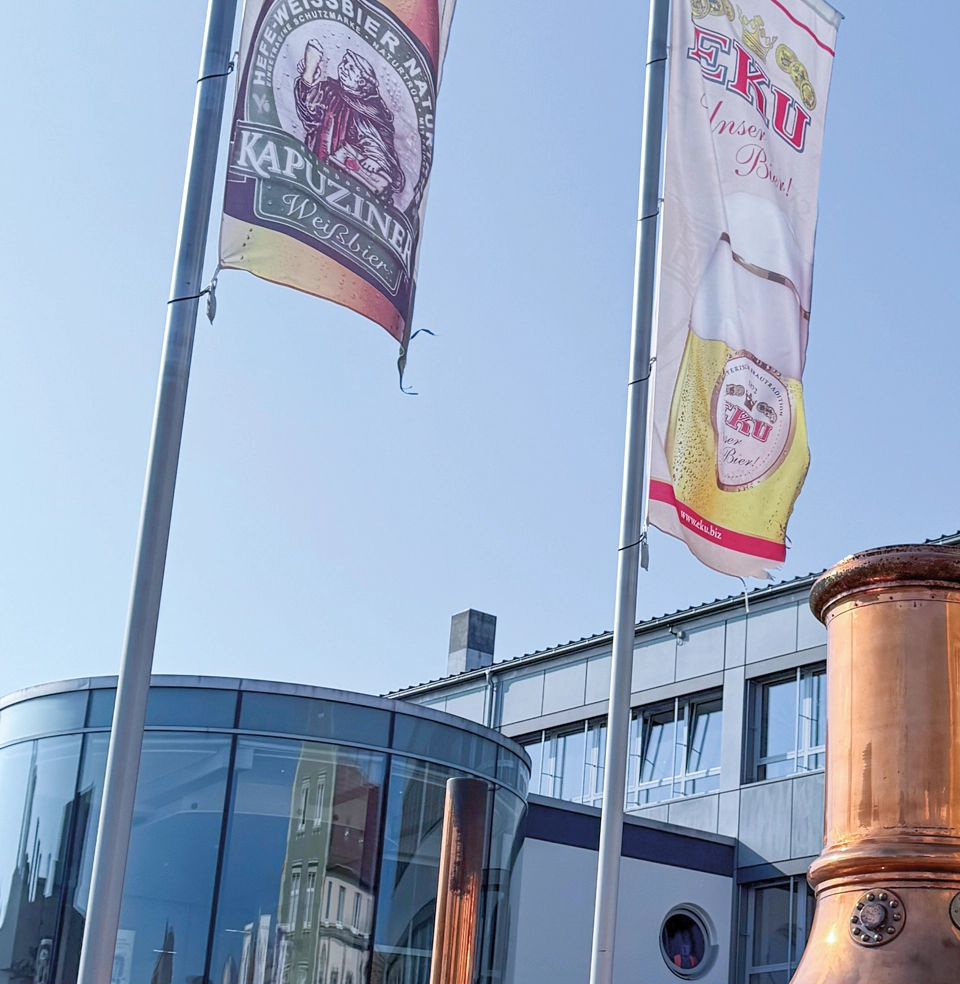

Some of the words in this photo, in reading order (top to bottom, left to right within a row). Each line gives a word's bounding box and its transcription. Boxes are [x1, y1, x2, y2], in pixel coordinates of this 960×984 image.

[293, 10, 361, 35] SCHUTZMARKE
[686, 23, 812, 154] EKU
[236, 129, 413, 278] KAPUZINER
[734, 143, 793, 197] Bier!
[282, 193, 391, 273] Weißbier
[679, 510, 723, 540] www.eku.biz
